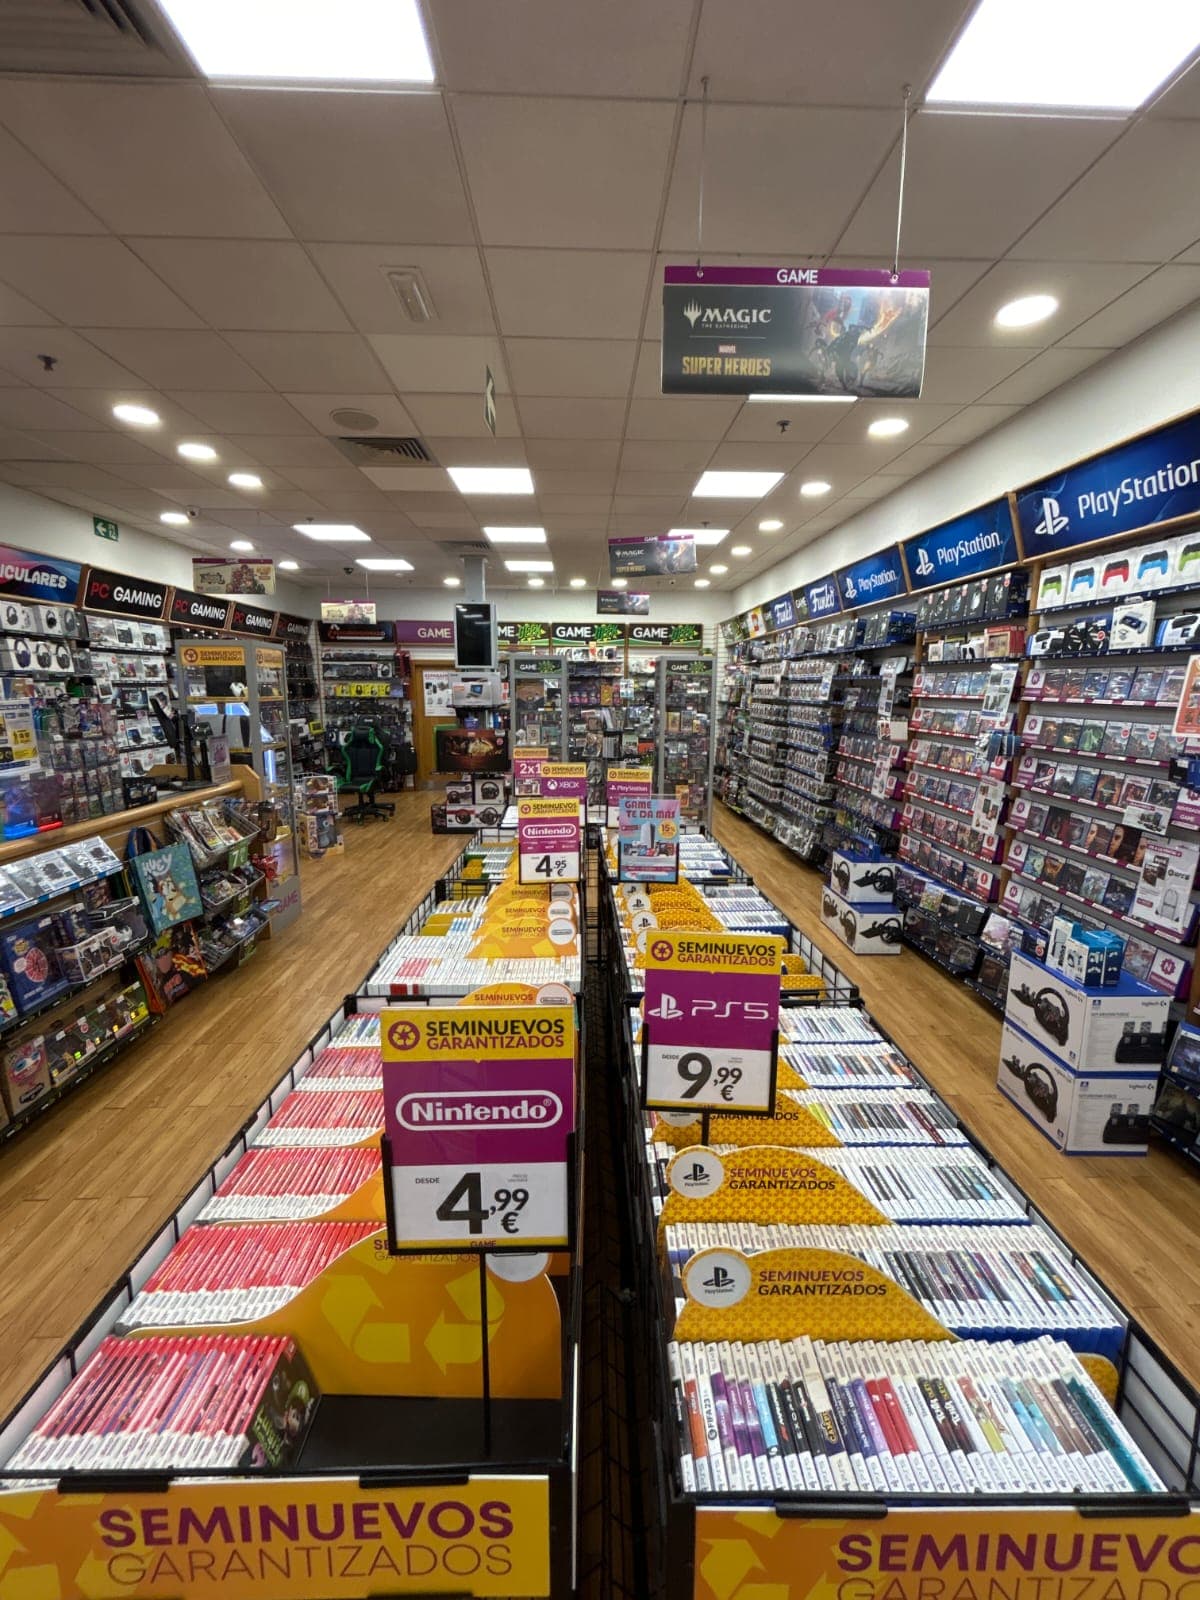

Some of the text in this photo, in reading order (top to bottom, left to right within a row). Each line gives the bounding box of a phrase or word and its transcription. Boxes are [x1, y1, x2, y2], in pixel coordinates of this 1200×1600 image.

[776, 269, 818, 284] GAME
[701, 308, 772, 323] MAGIC
[682, 356, 771, 377] SUPER HEROES
[936, 531, 1000, 566] PlayStation
[858, 569, 897, 593] PlayStation
[90, 582, 162, 608] PC GAMING
[809, 583, 835, 613] Funko
[175, 599, 226, 620] PC GAMING
[245, 614, 273, 629] GAMING
[417, 627, 451, 639] GAME
[498, 626, 514, 637] ME
[556, 626, 592, 638] GAME
[633, 627, 668, 638] GAME
[532, 802, 577, 810] SEMINUEVOS
[625, 801, 652, 809] GAME
[527, 826, 573, 836] Nintendo
[677, 941, 776, 957] SEMINUEVOS
[677, 953, 775, 967] GARANTIZADOS
[474, 993, 534, 1001] SEMINUEVOS
[691, 999, 770, 1020] PS5
[425, 1018, 565, 1037] SEMINUEVOS
[426, 1034, 565, 1050] GARANTIZADOS
[720, 1085, 734, 1101] €
[729, 1167, 817, 1179] SEMINUEVOS
[729, 1180, 836, 1191] GARANTIZADOS
[501, 1211, 519, 1234] €
[759, 1270, 864, 1283] SEMINUEVOS
[758, 1283, 887, 1297] GARANTIZADOS
[703, 1397, 715, 1429] FIFA 23
[101, 1500, 514, 1549] SEMINUEVOS
[107, 1543, 513, 1587] GARANTIZADOS
